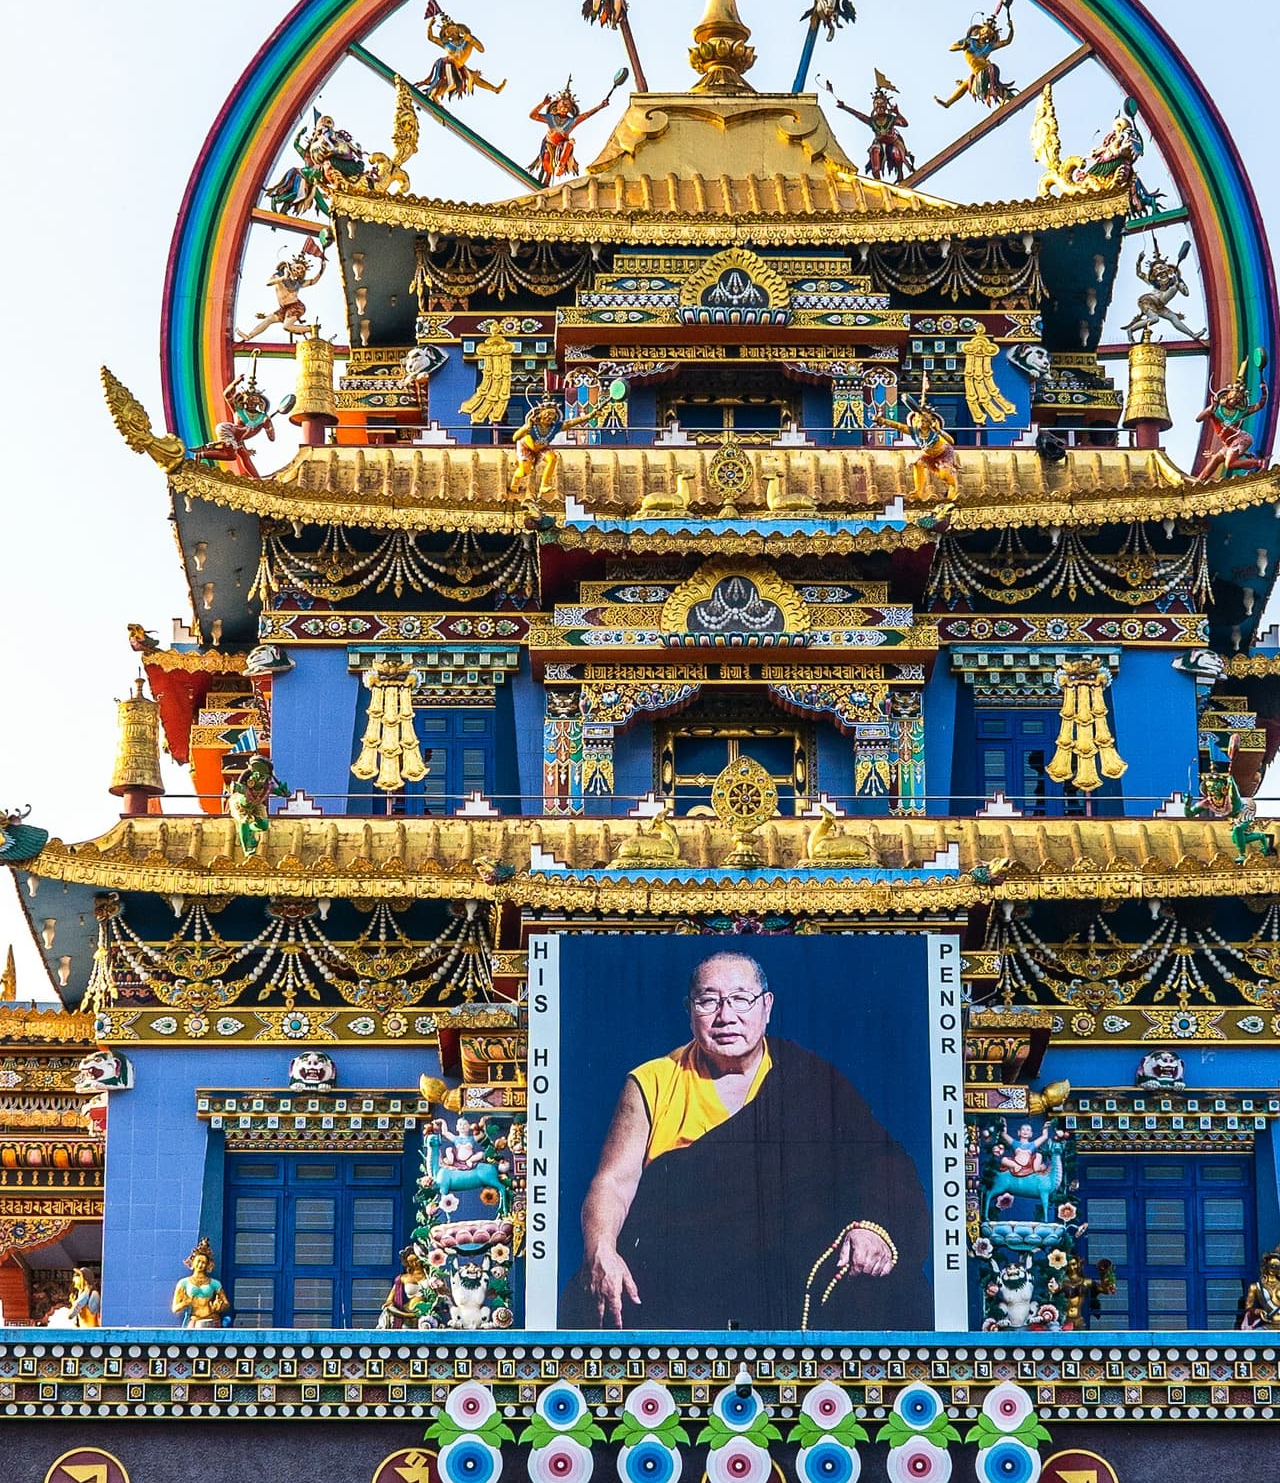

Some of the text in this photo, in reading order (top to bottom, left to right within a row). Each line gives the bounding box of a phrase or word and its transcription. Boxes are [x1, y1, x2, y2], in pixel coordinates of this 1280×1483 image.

[531, 940, 549, 1261] HIS HOLINESS
[939, 942, 961, 1271] PENOR RINPOCHE
